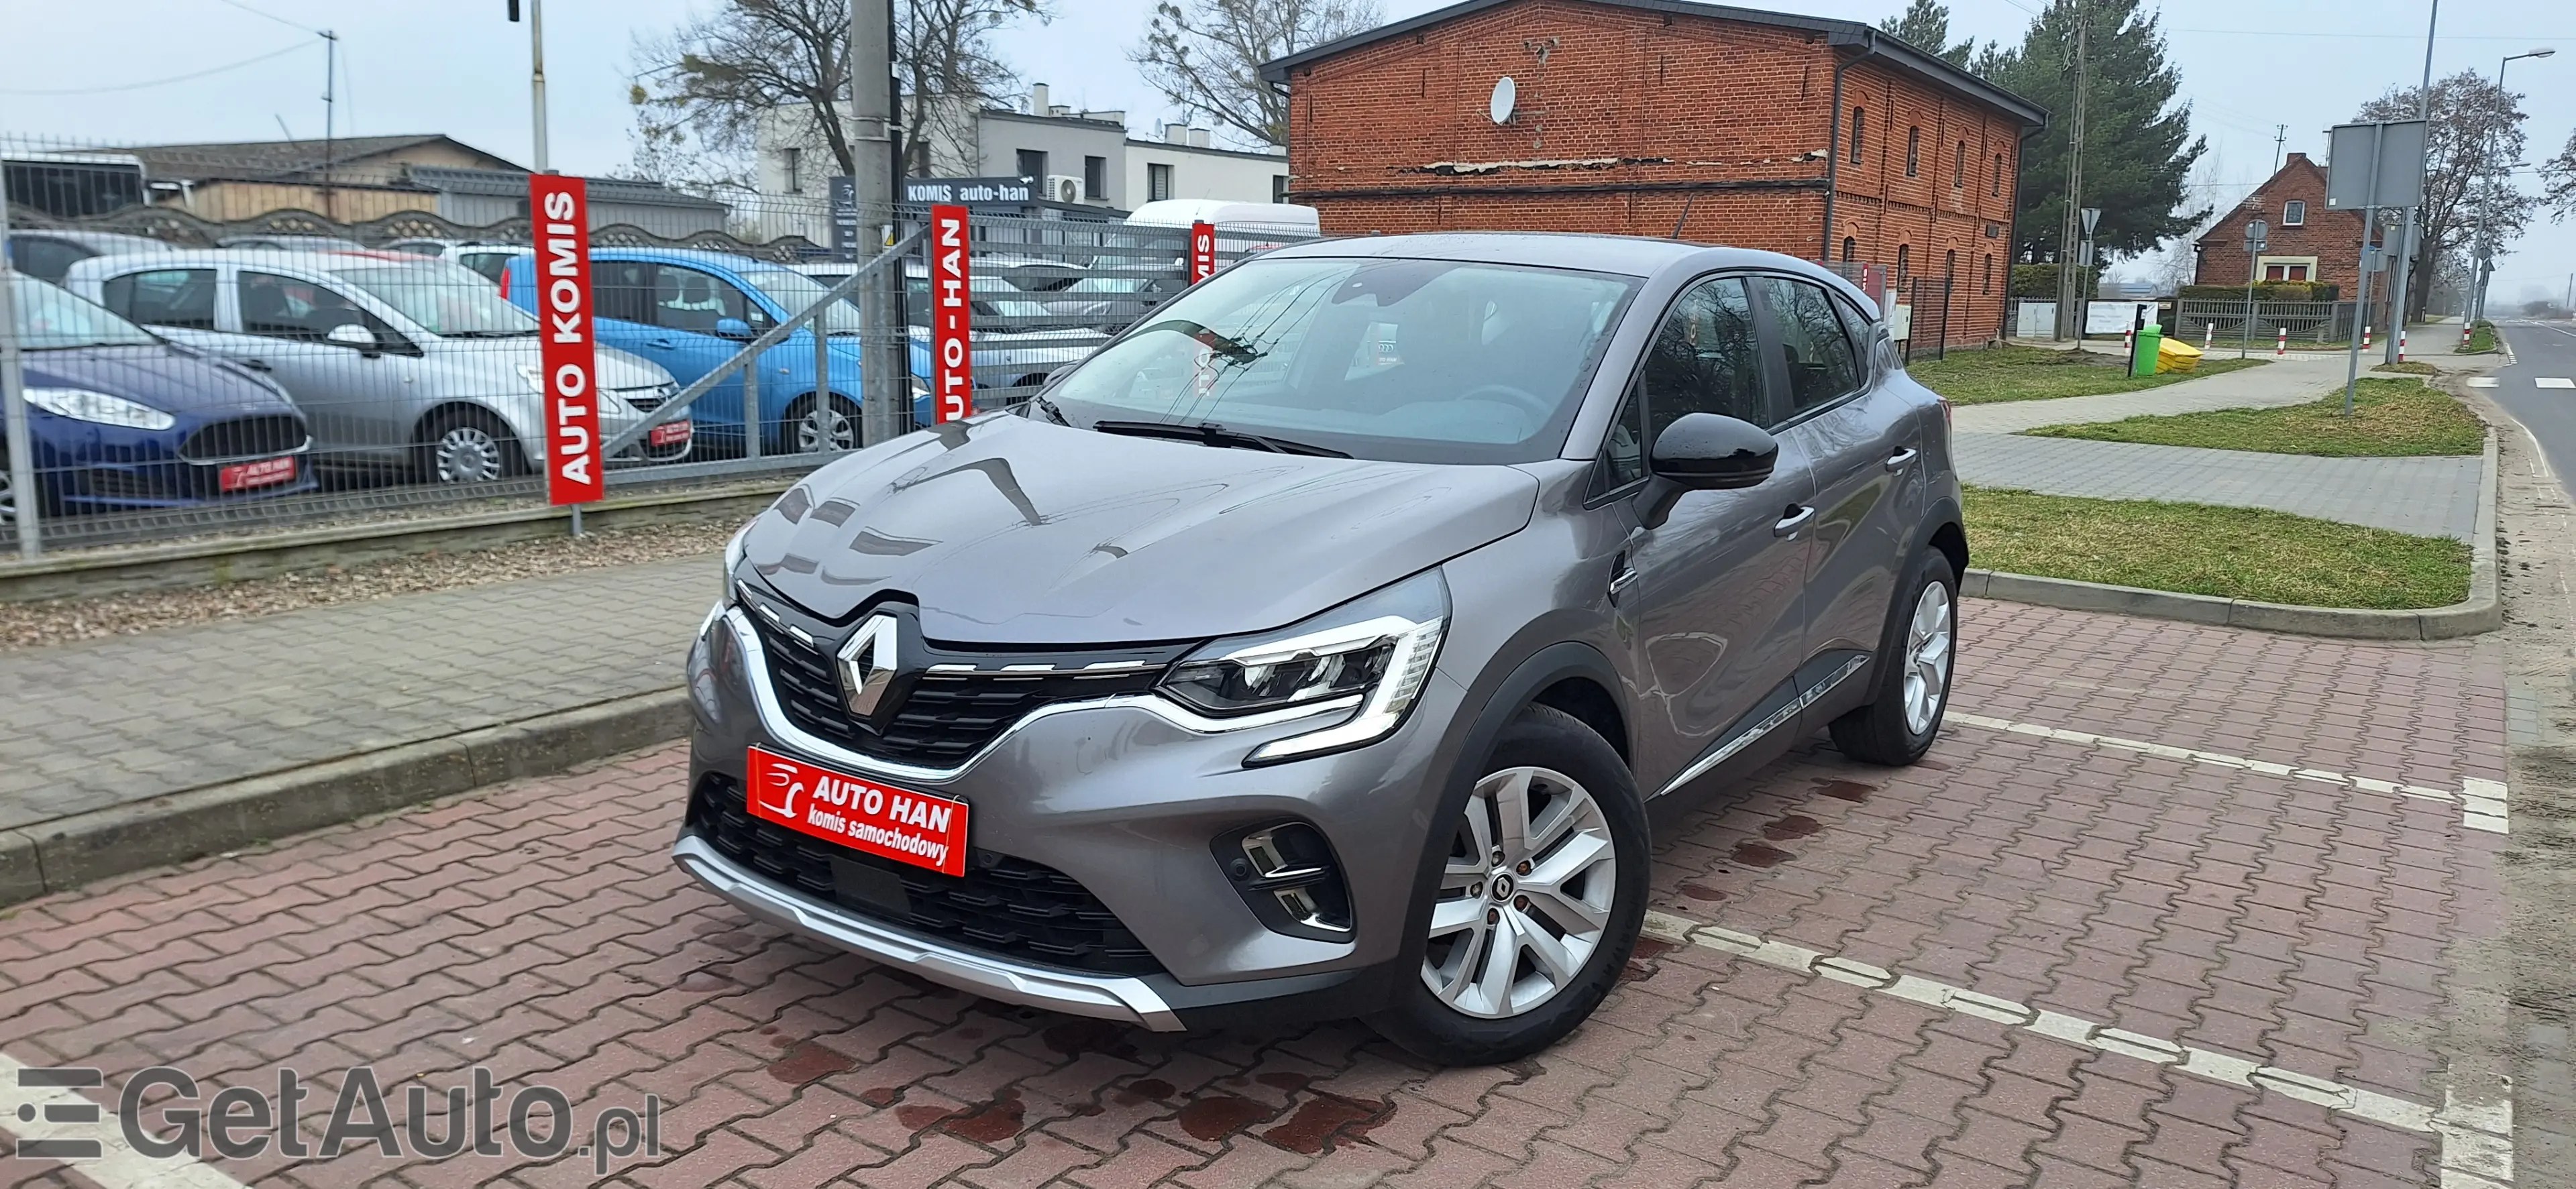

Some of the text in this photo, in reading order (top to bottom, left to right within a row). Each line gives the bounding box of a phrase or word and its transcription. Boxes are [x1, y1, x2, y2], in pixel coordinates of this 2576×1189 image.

[908, 184, 1029, 201] KOMIS auto-han
[545, 190, 591, 485] AUTO KOMIS
[812, 775, 951, 833] AUTO HAN
[807, 803, 949, 866] komis samochodowy
